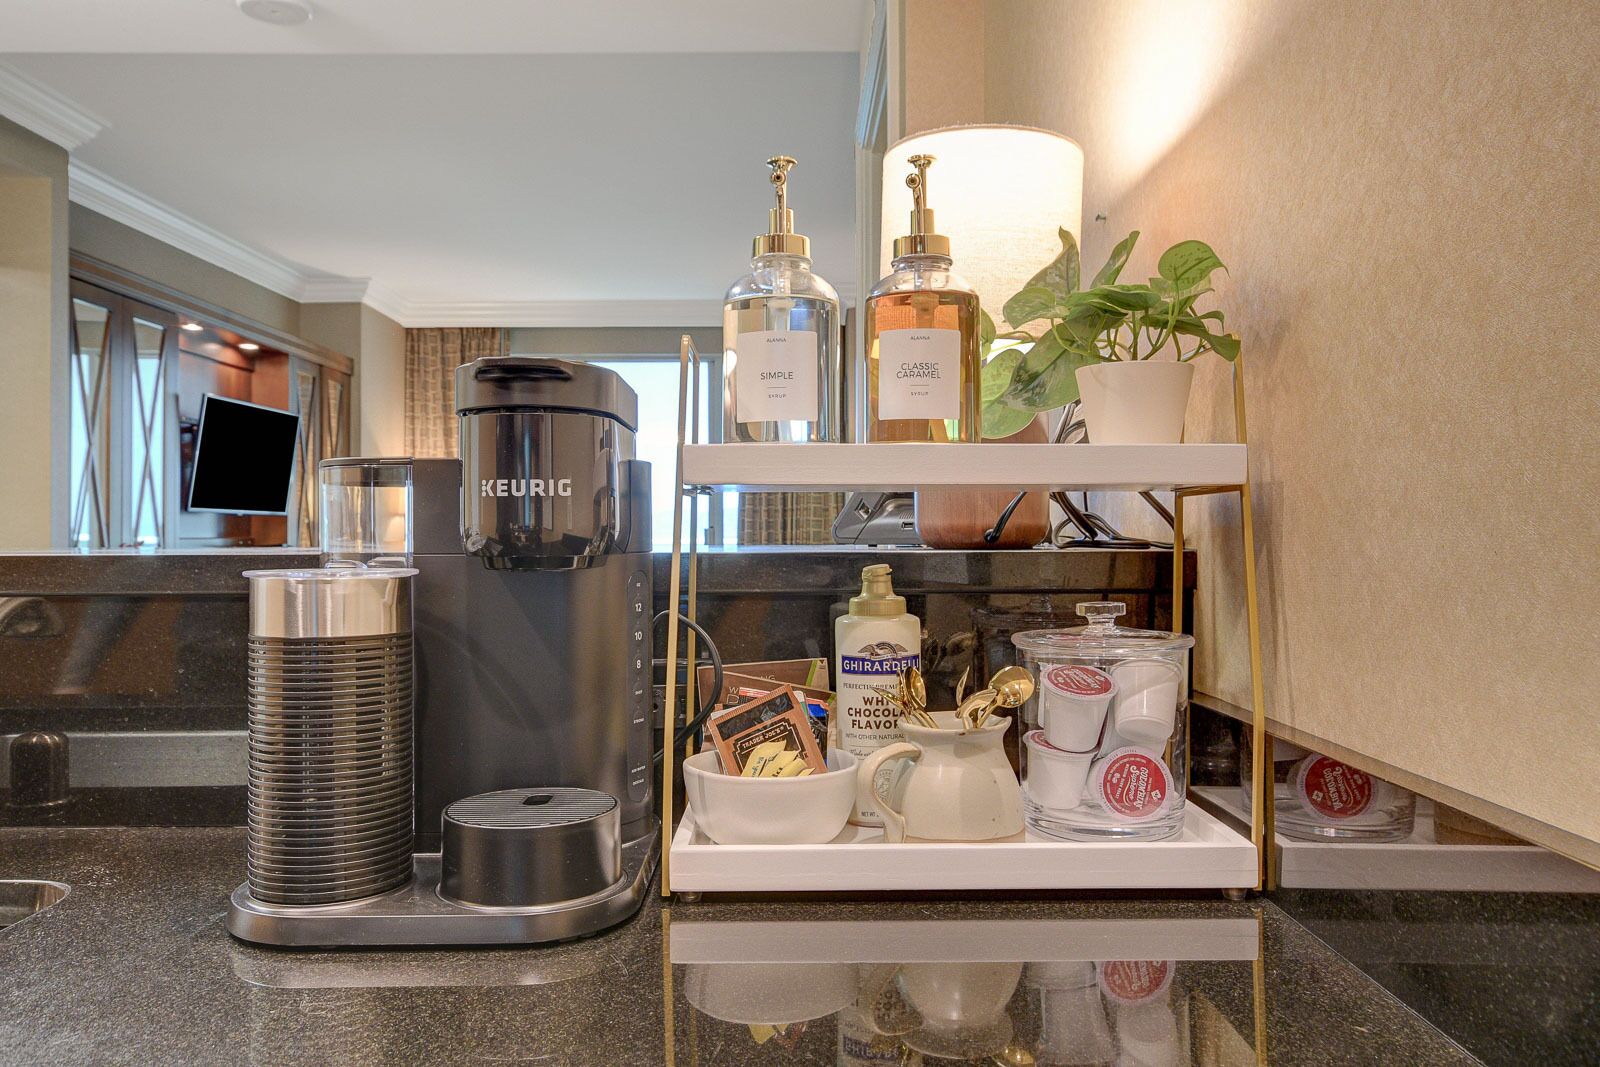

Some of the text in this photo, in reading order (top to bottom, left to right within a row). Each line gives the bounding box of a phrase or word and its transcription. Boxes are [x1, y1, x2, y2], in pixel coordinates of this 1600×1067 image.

[901, 362, 939, 371] CLASSIC
[760, 371, 794, 380] SIMPLE
[896, 370, 941, 379] CARAMEL
[481, 479, 572, 497] KEURIG
[635, 602, 642, 612] 12
[634, 631, 642, 641] 10
[636, 659, 642, 669] 8
[862, 696, 890, 706] WHI
[847, 707, 906, 718] CHOCOLA
[851, 719, 900, 730] FLAVOR
[741, 735, 765, 749] TRADER
[1133, 766, 1149, 810] COLOMBIAN
